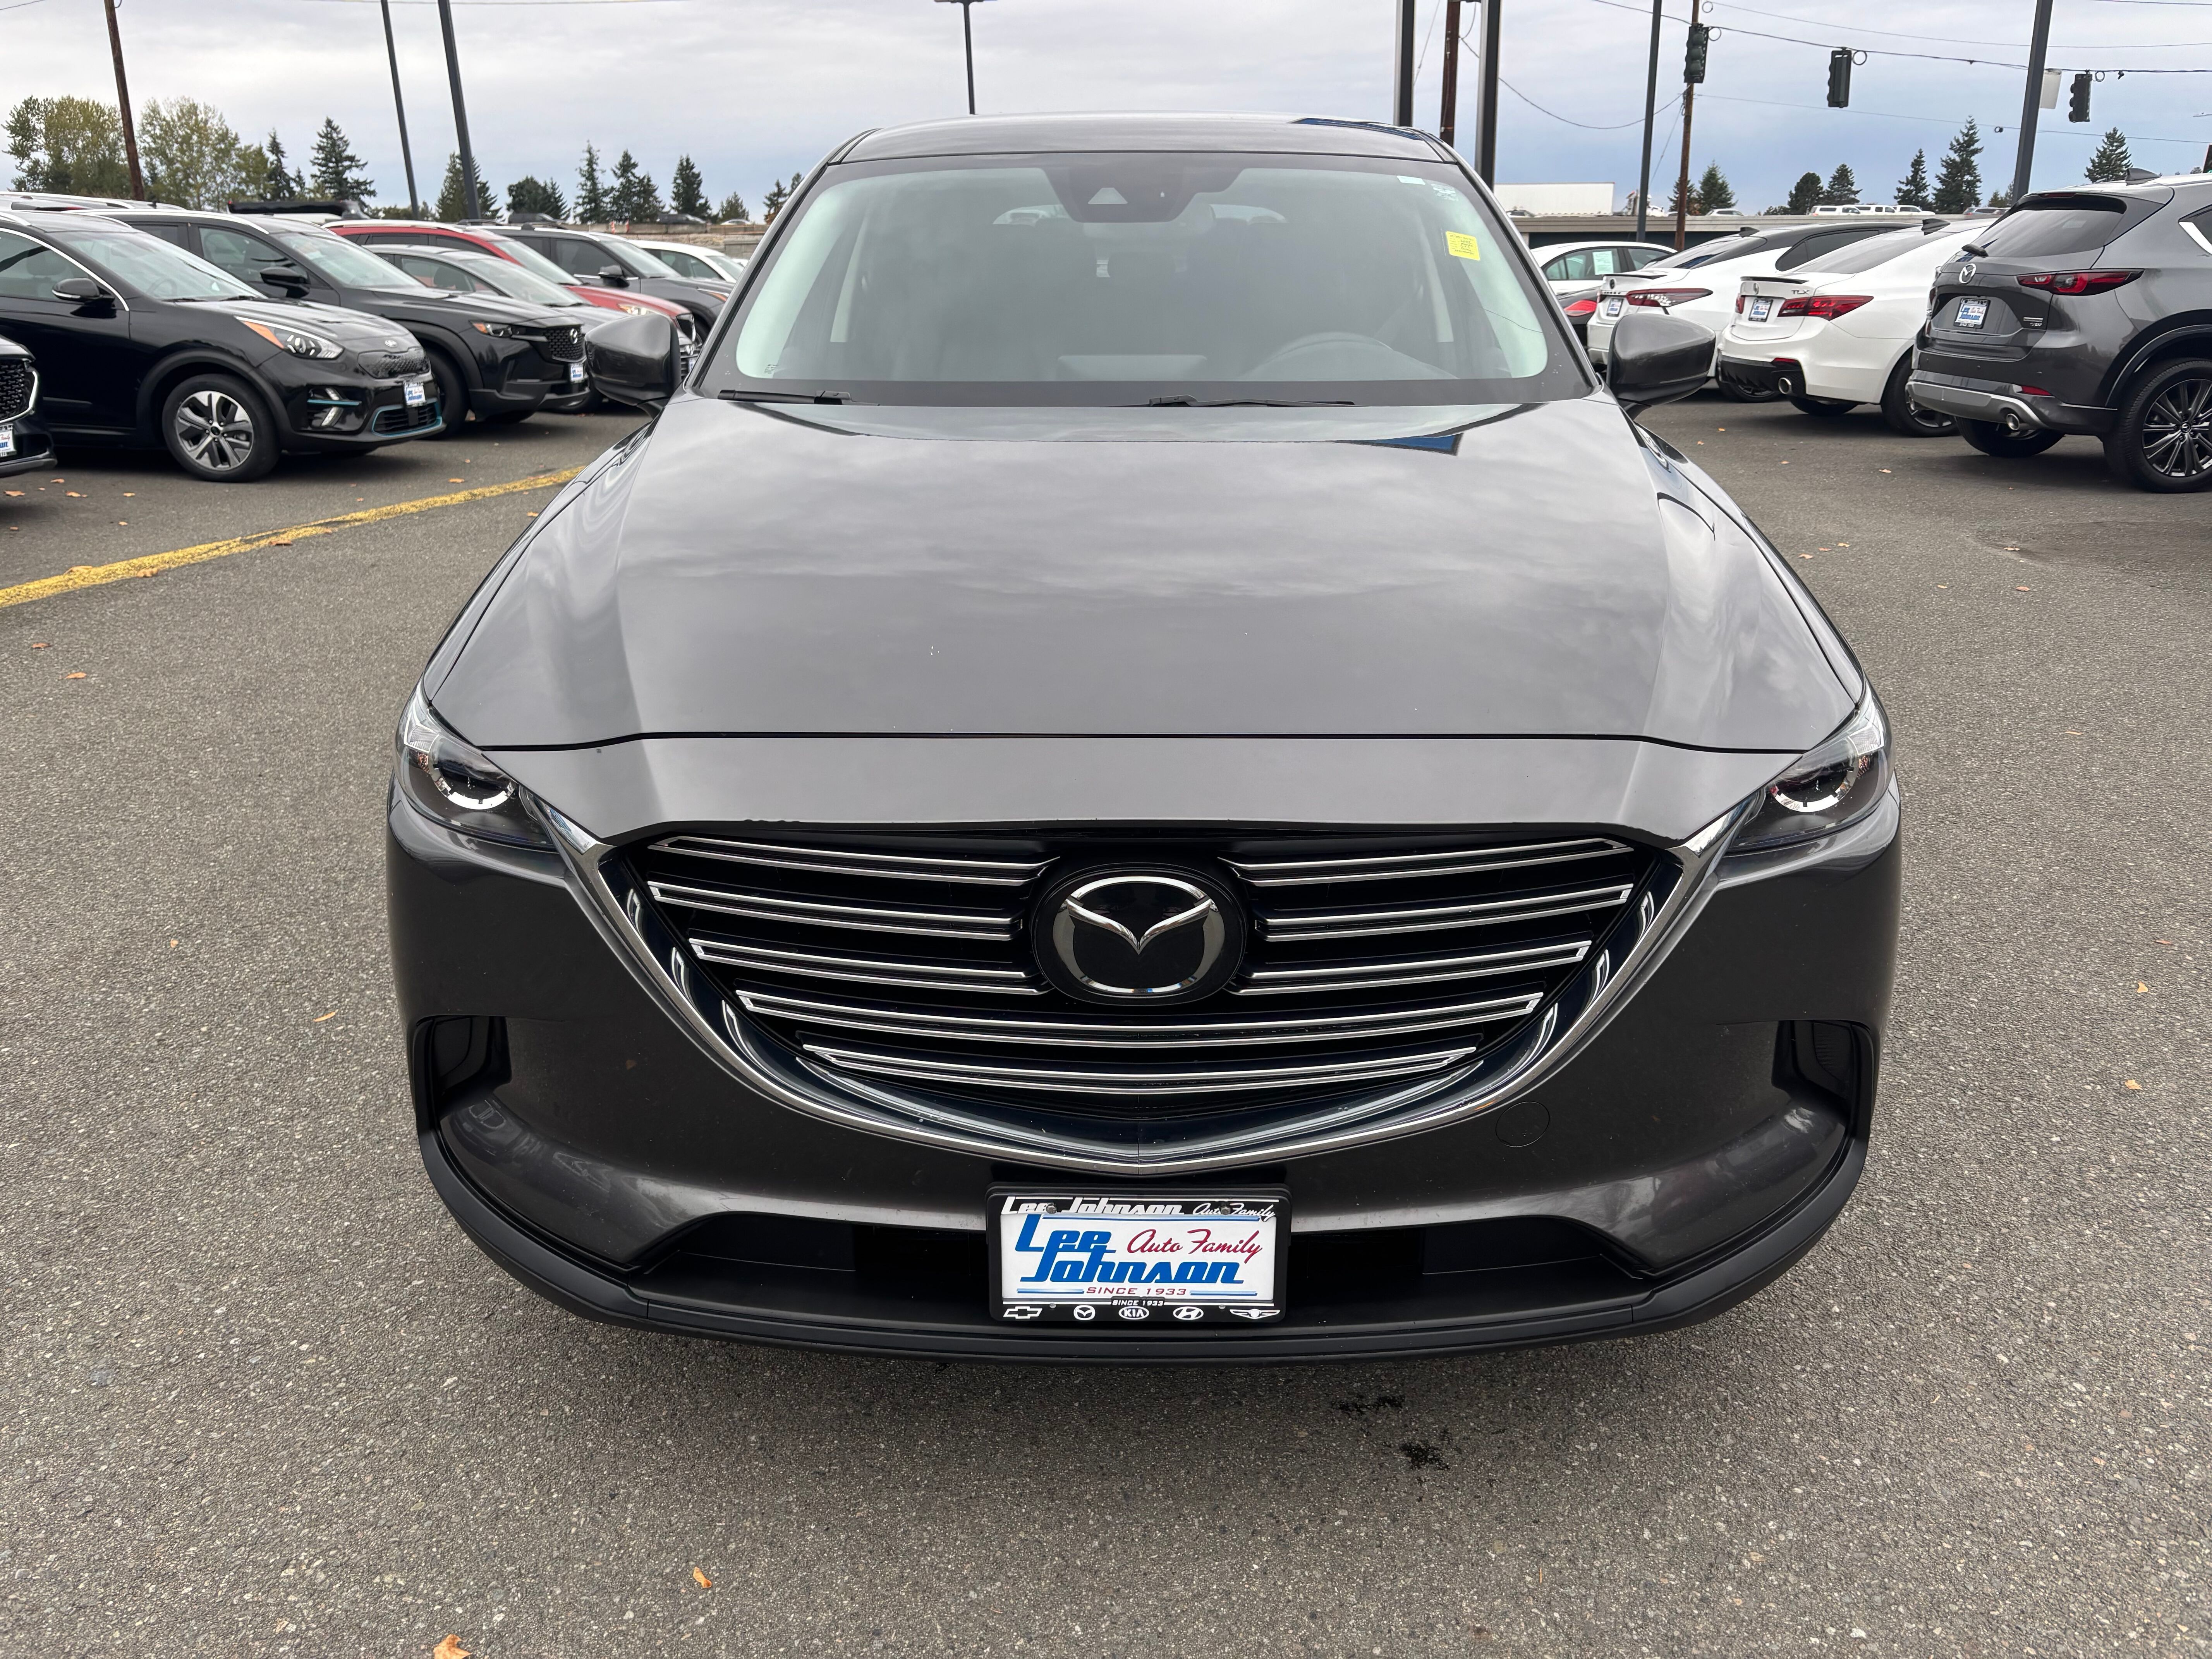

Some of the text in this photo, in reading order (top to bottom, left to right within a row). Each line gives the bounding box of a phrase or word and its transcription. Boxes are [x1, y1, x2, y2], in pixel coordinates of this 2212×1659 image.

[1061, 1197, 1184, 1214] Johnson
[1192, 1203, 1224, 1215] Aut
[1230, 1203, 1276, 1222] Family
[1015, 1214, 1116, 1253] Lee
[1127, 1229, 1262, 1264] Auto Family
[1020, 1249, 1244, 1284] Johnson
[1124, 1309, 1144, 1317] KIA
